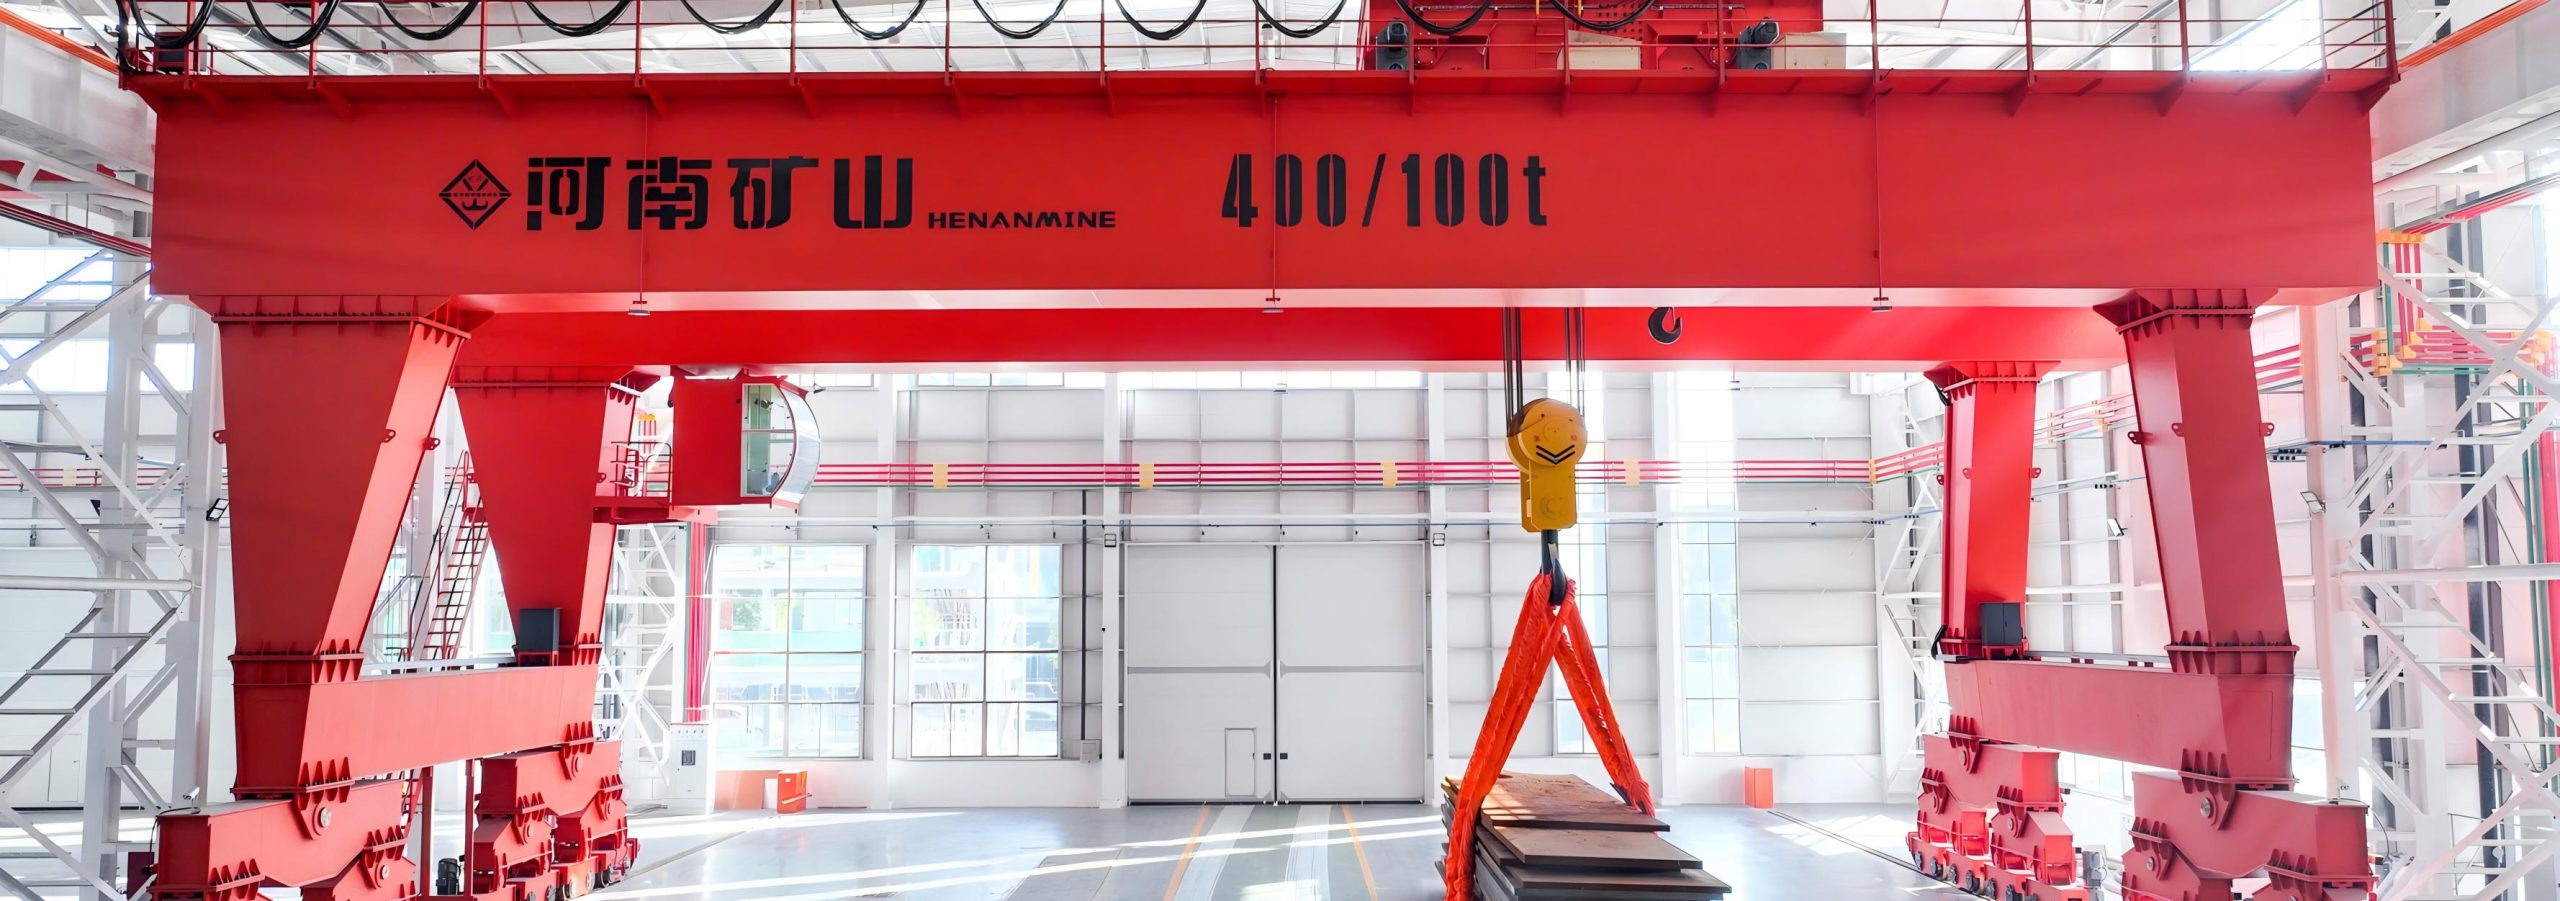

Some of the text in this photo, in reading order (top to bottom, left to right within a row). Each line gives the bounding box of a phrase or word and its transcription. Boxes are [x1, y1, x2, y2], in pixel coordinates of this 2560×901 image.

[526, 154, 914, 231] 河南矿山
[928, 211, 1115, 229] HENANMINE
[1221, 153, 1547, 228] 400/100t
